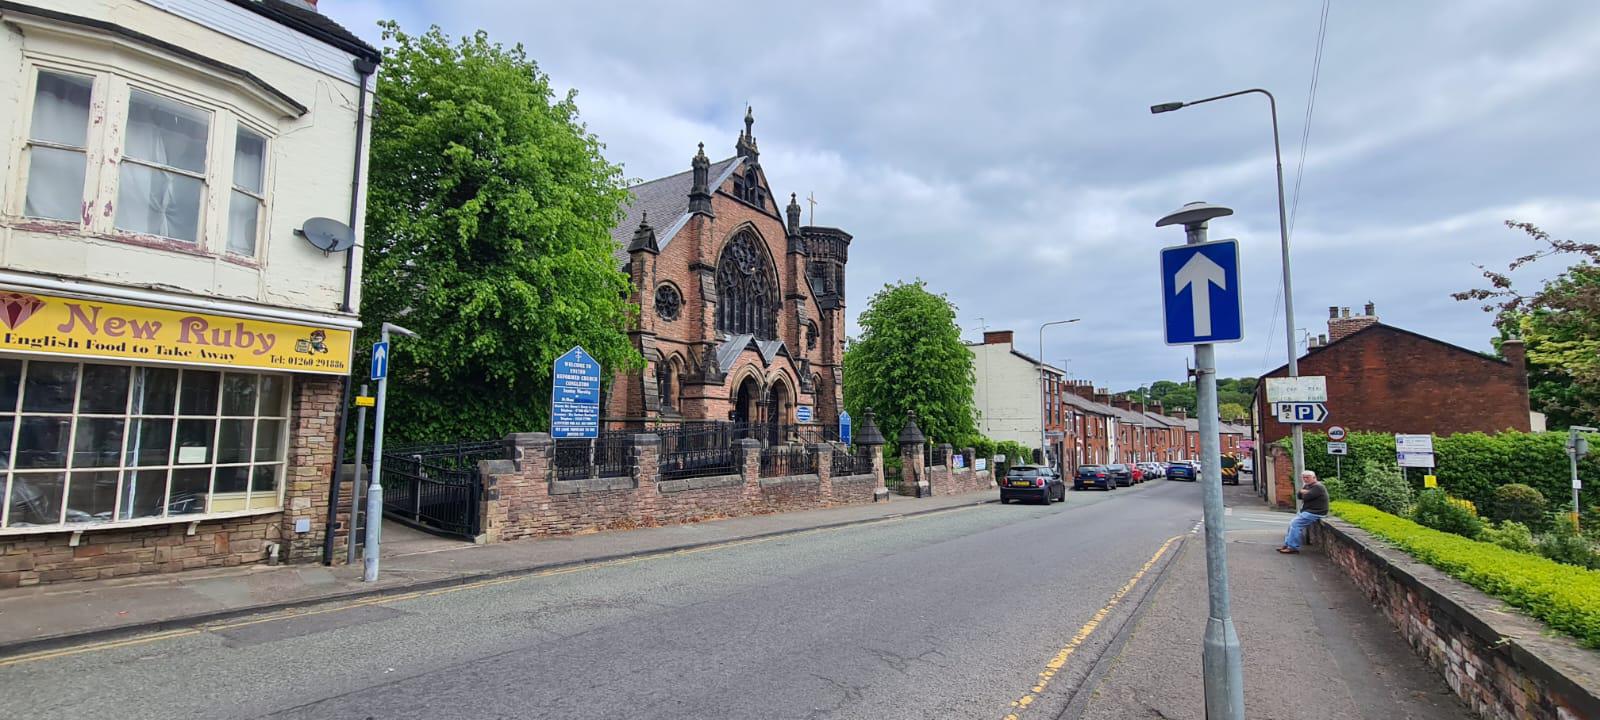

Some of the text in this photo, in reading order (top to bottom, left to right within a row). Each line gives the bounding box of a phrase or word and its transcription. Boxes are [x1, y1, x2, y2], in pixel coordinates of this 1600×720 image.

[57, 303, 276, 355] New Ruby
[5, 333, 236, 363] English Food to Take Away
[271, 355, 286, 365] Tel:
[288, 357, 313, 367] 01260
[1298, 406, 1311, 420] P
